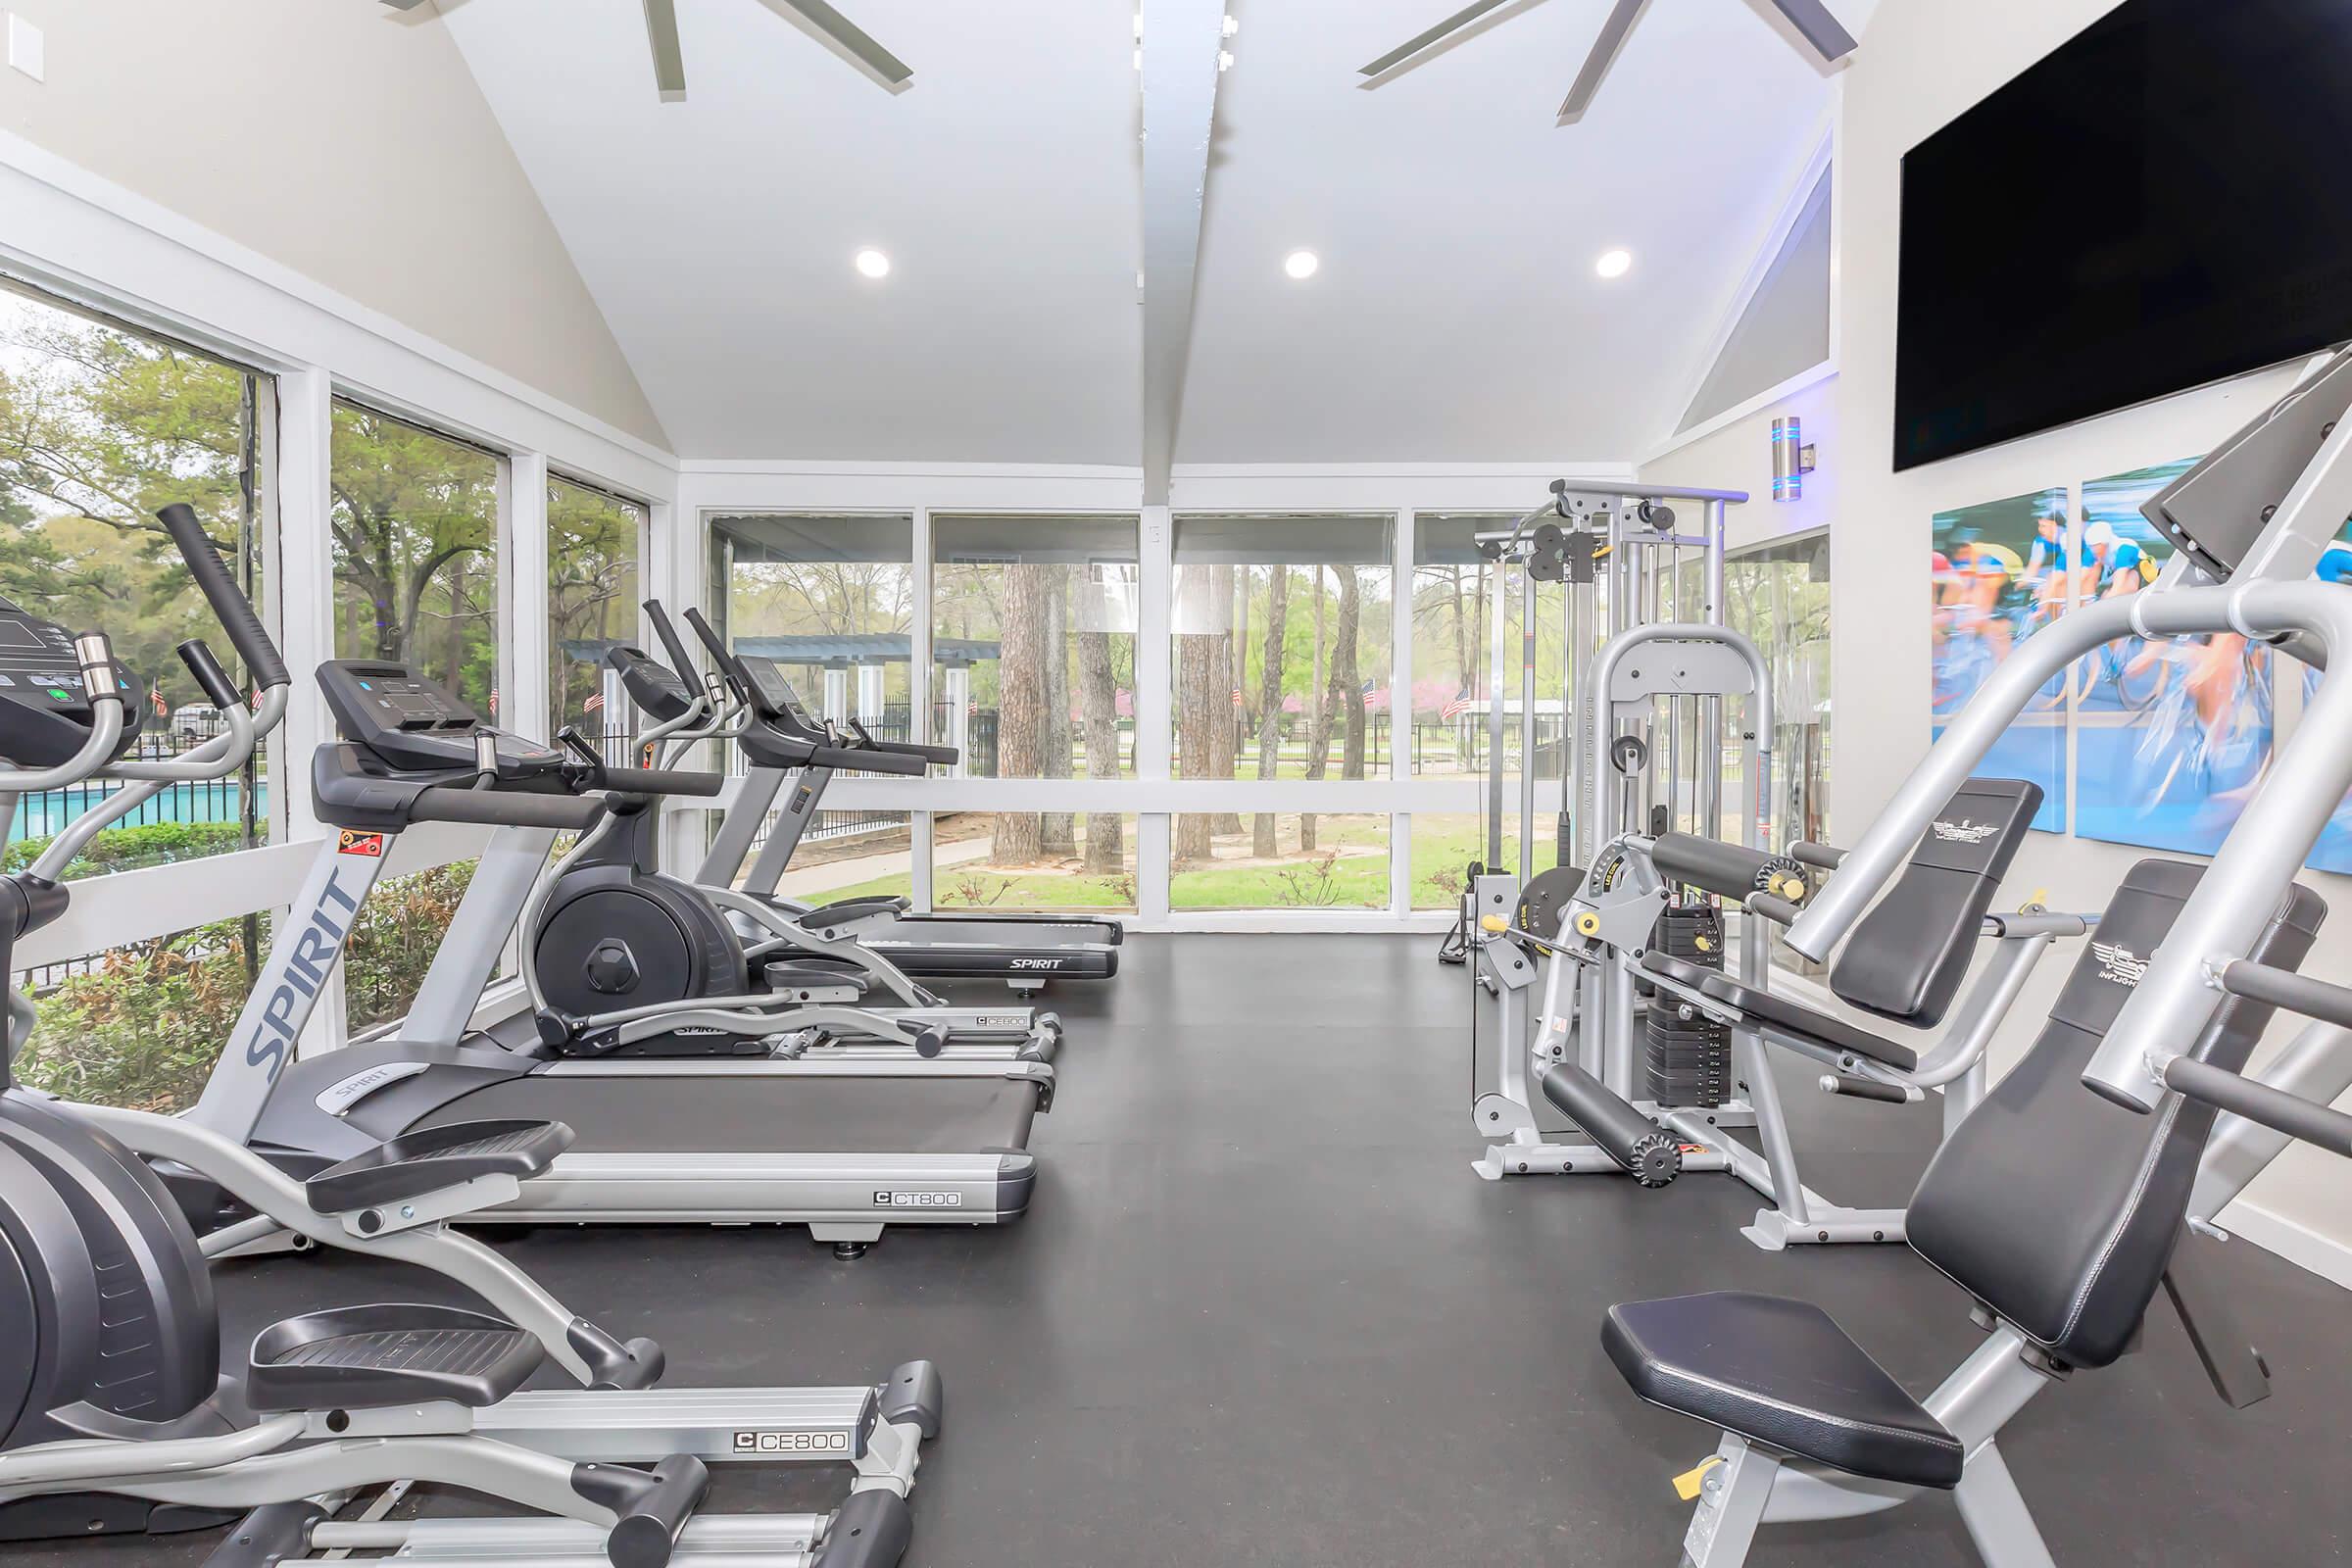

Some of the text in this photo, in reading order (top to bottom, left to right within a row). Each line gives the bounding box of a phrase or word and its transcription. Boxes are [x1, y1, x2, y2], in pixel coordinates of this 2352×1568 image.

[1009, 959, 1063, 969] SPIRIT
[247, 865, 357, 1084] SPIRIT
[2098, 970, 2138, 988] INFLIGH
[336, 1070, 388, 1098] SPIRIT
[894, 1194, 959, 1205] CT800
[760, 1434, 846, 1449] CE800
